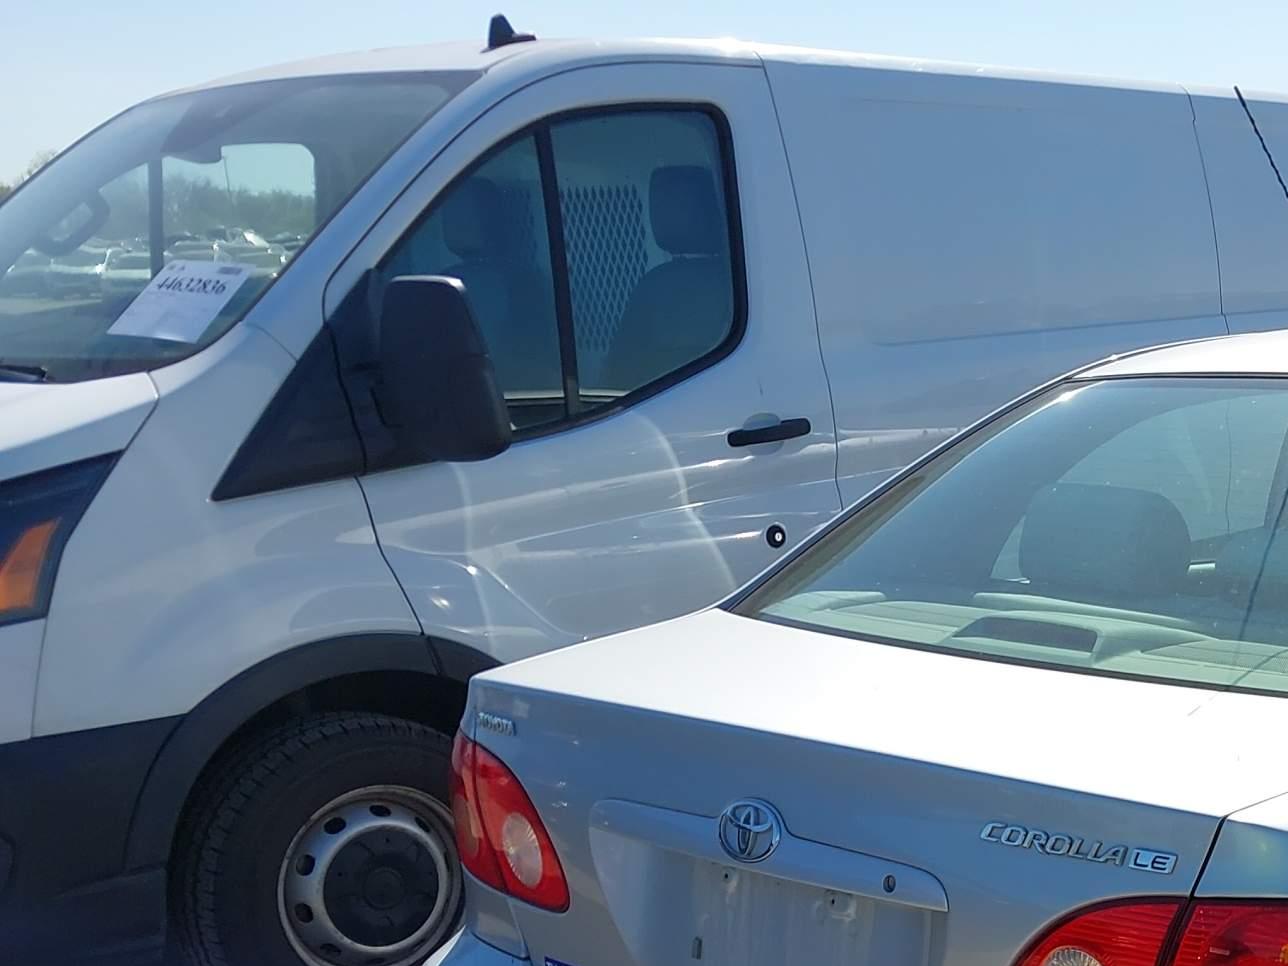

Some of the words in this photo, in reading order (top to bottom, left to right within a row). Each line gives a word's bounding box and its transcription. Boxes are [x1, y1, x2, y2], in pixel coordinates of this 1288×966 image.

[157, 276, 227, 295] 44632836
[478, 711, 515, 736] TOYOTA
[980, 822, 1128, 866] COROLLA
[1133, 851, 1171, 872] LE
